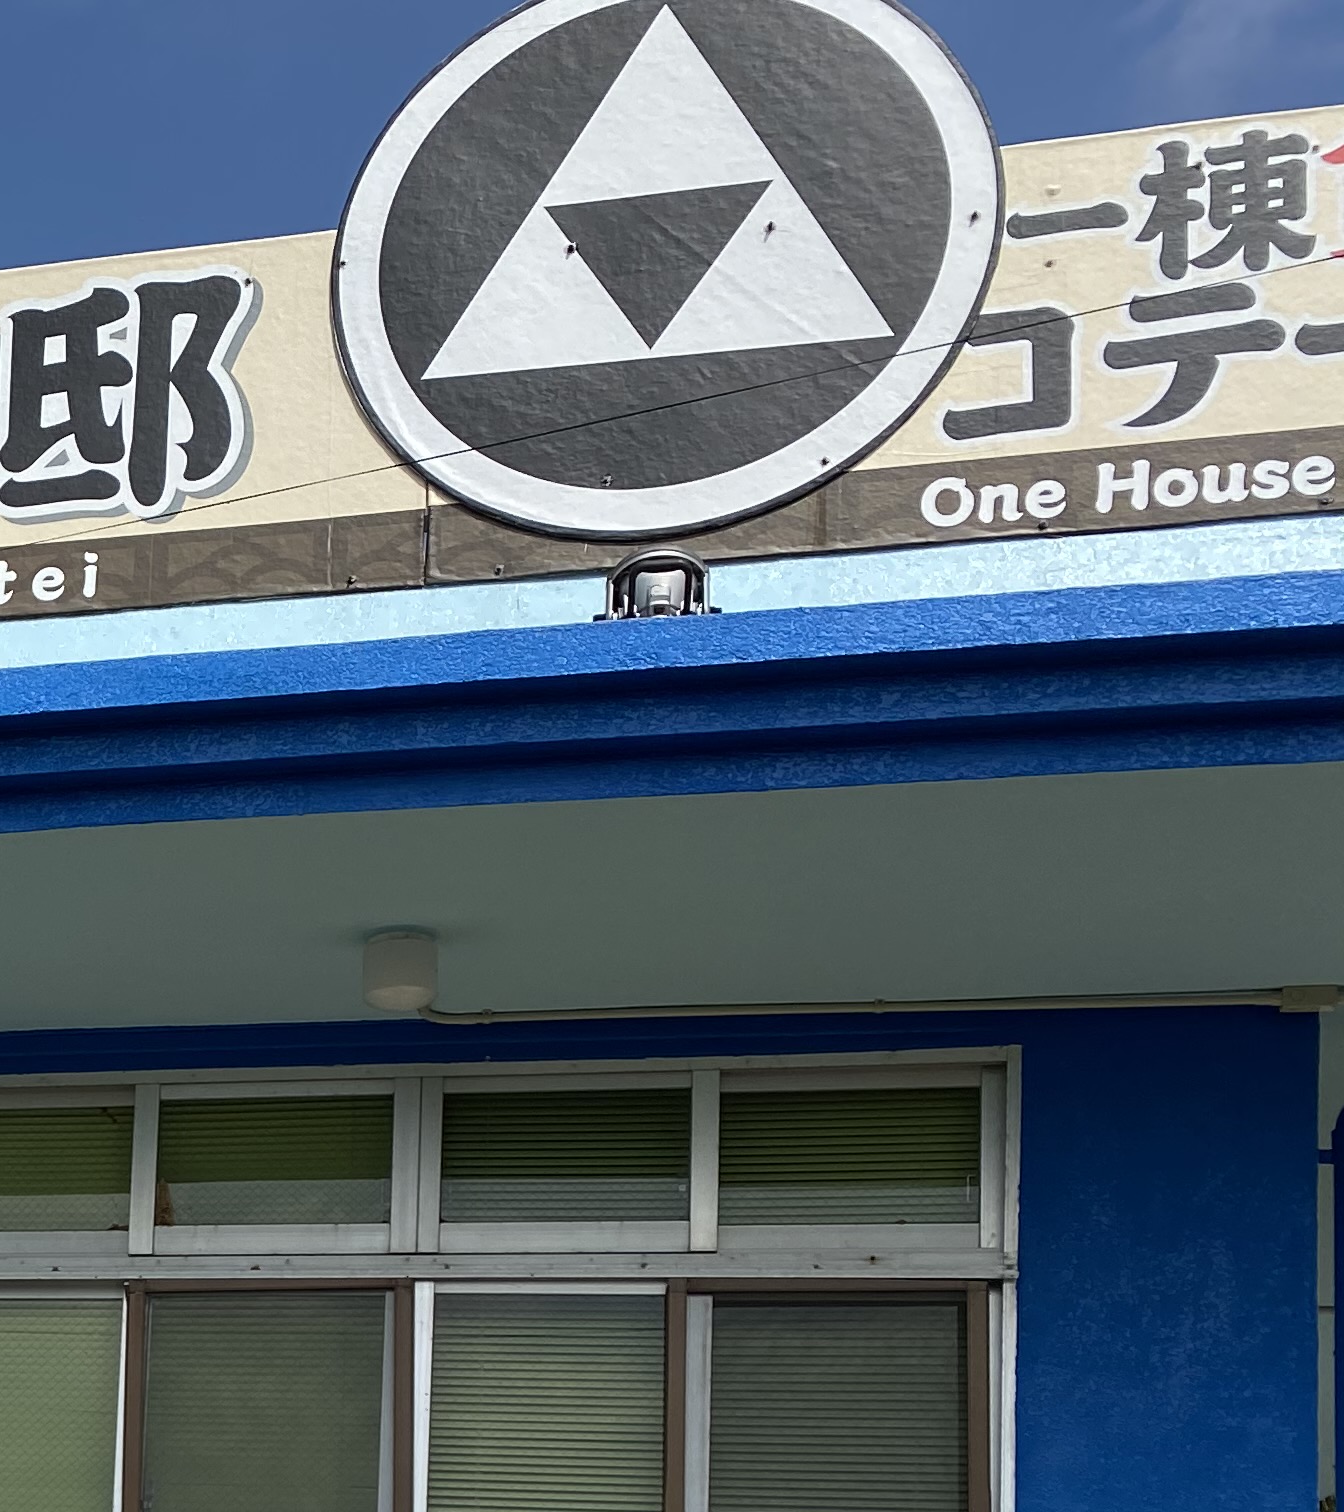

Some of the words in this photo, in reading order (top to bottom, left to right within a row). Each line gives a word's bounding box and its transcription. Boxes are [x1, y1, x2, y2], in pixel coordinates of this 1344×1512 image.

[1007, 131, 1344, 279] 一棟
[920, 476, 1067, 528] One
[1095, 455, 1337, 514] House
